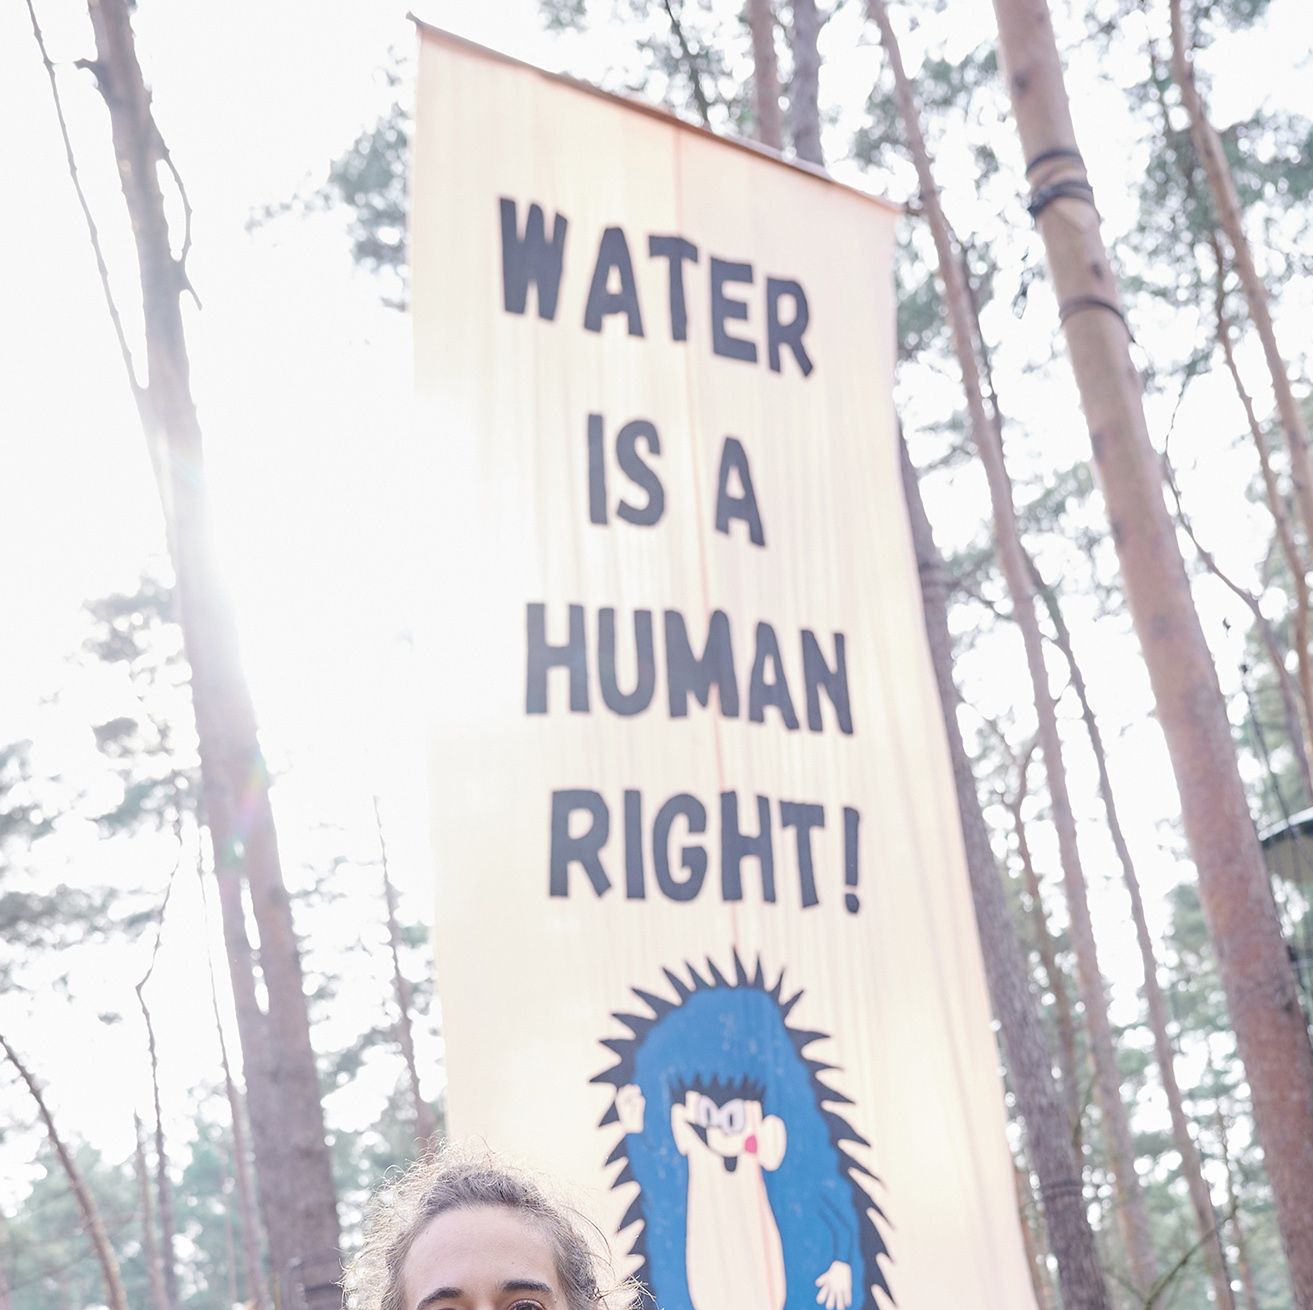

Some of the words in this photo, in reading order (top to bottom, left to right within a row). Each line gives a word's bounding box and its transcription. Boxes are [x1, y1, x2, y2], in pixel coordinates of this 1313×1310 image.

[498, 196, 815, 379] WATER
[586, 412, 666, 528] IS
[714, 435, 767, 549] A
[525, 602, 855, 737] HUMAN
[548, 788, 861, 916] RIGHT!
